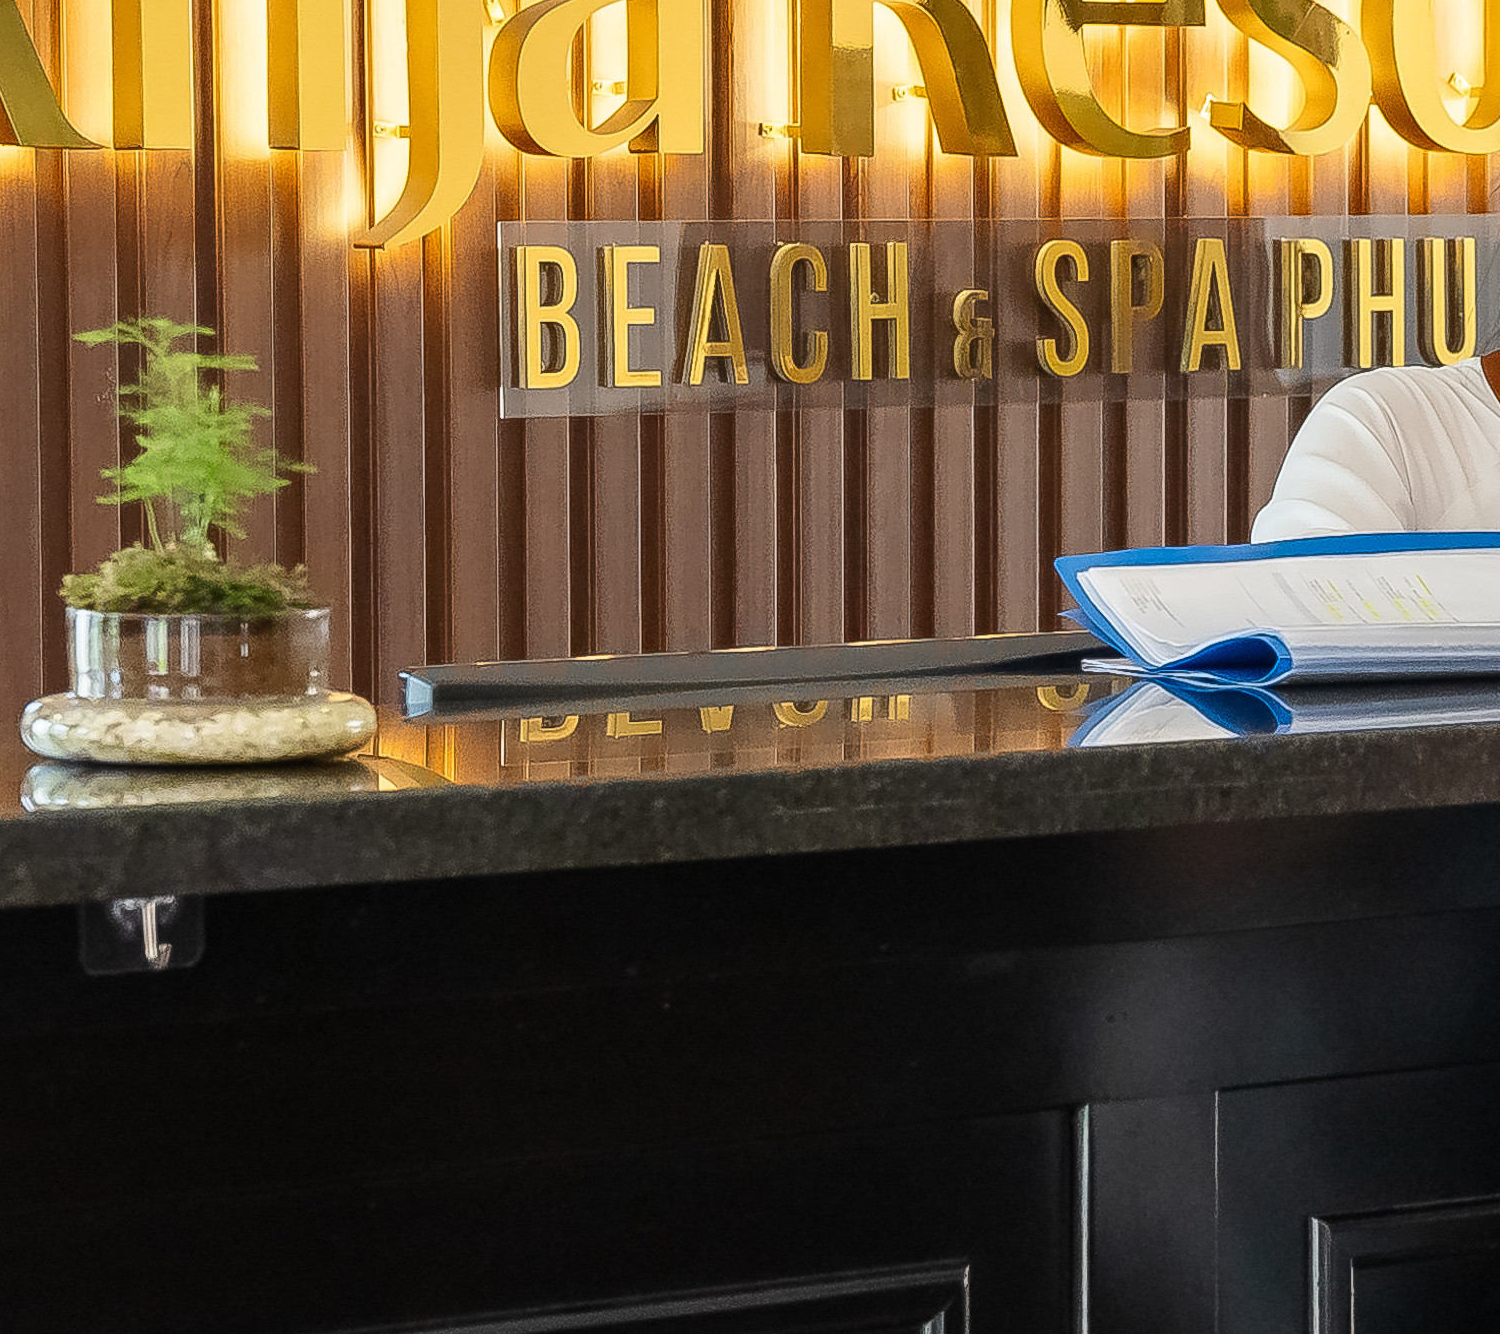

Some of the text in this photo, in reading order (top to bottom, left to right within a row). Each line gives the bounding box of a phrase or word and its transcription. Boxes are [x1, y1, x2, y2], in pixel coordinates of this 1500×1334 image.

[511, 239, 911, 390] BEACH
[953, 288, 995, 381] &
[1035, 237, 1242, 379] SPA
[1282, 235, 1477, 370] PHU
